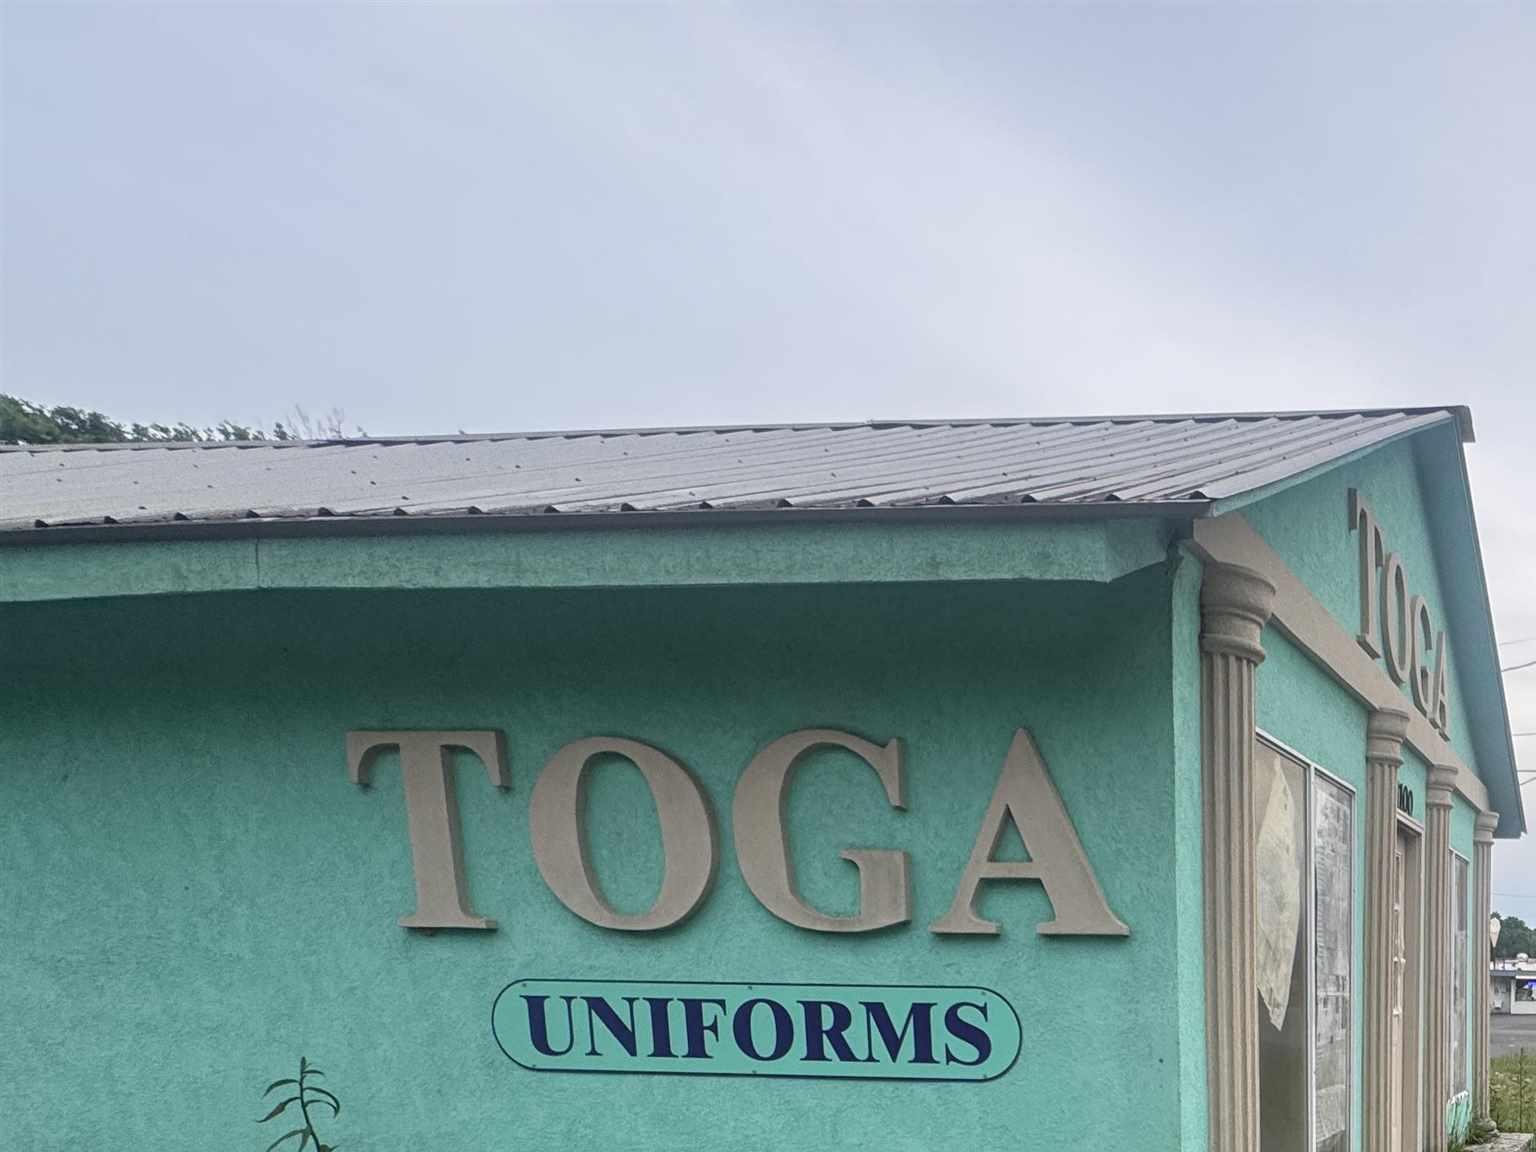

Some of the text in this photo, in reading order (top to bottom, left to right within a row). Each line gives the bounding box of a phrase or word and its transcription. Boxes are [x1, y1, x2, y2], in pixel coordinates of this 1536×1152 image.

[1347, 487, 1450, 742] TOGA
[346, 727, 1130, 937] TOGA
[519, 994, 992, 1067] UNIFORMS
